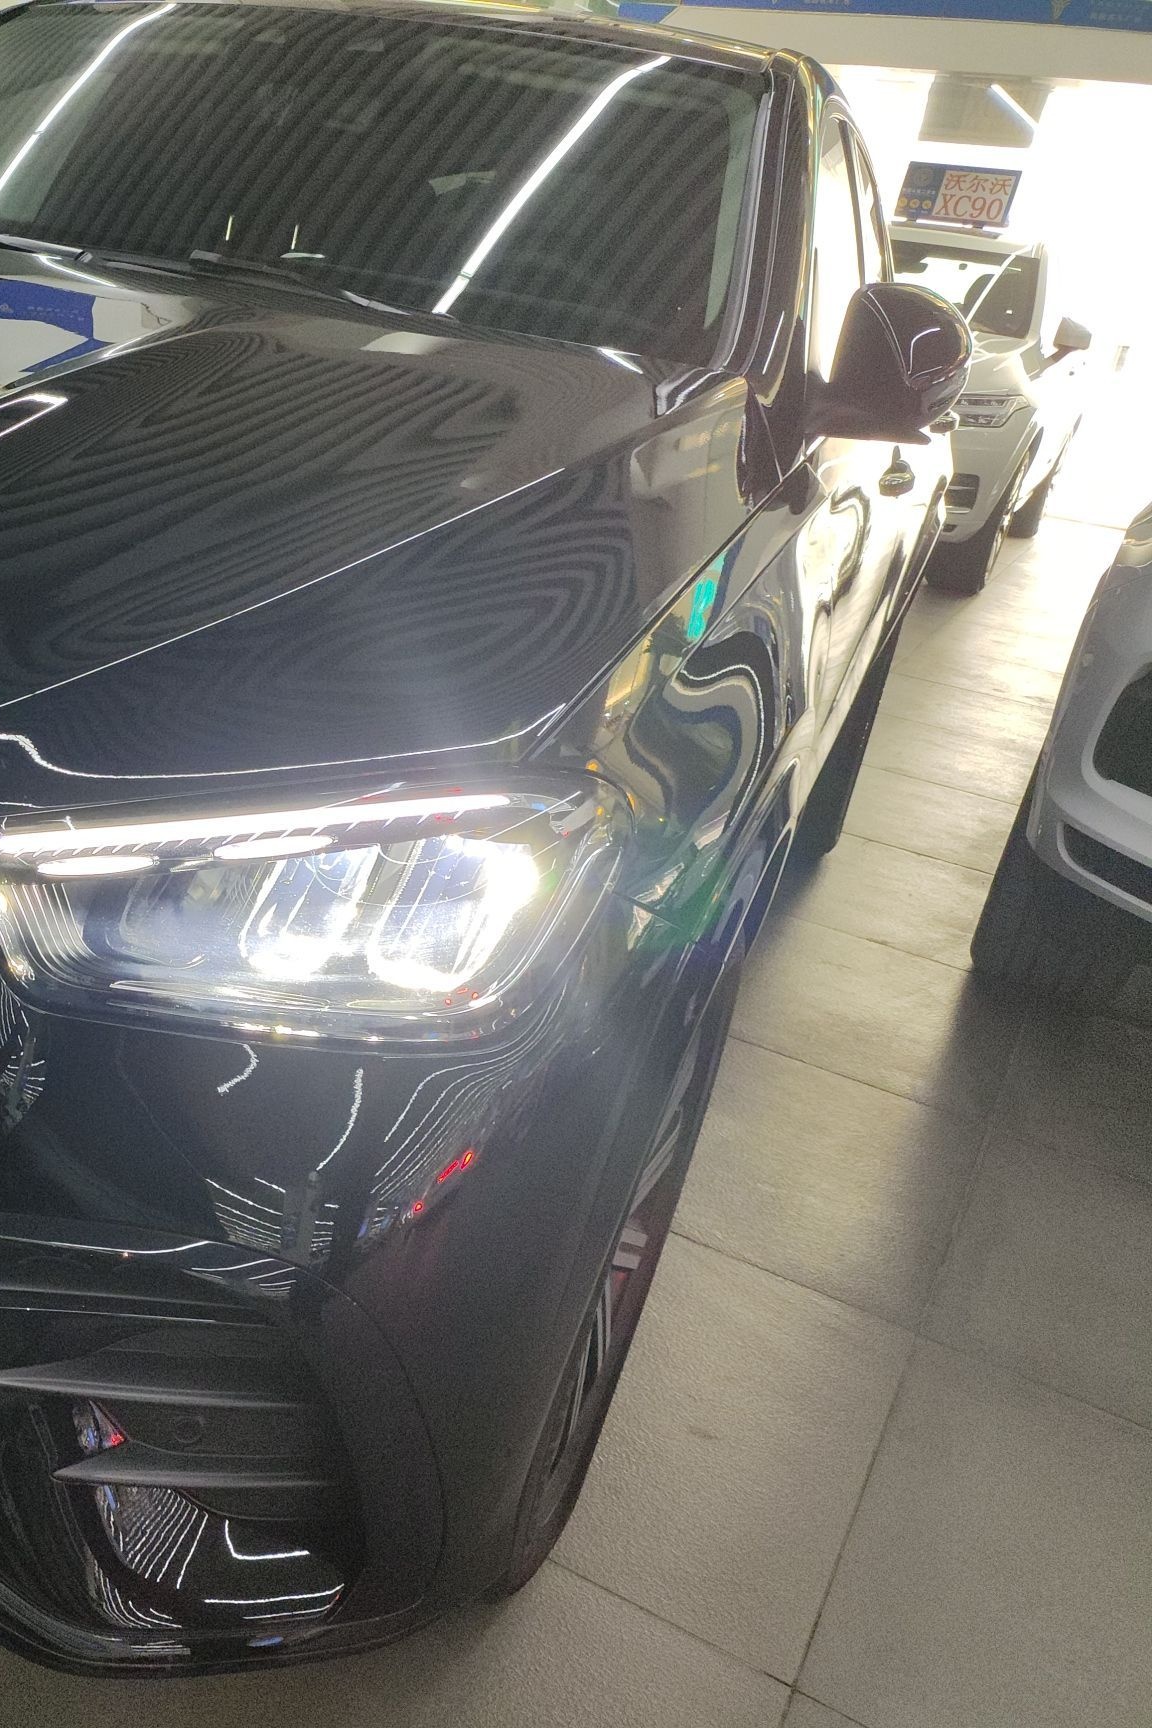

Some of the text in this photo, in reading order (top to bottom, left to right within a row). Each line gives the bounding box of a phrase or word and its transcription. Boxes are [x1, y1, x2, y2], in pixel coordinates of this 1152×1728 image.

[944, 173, 1012, 196] 沃尔沃
[936, 193, 1004, 220] XC90
